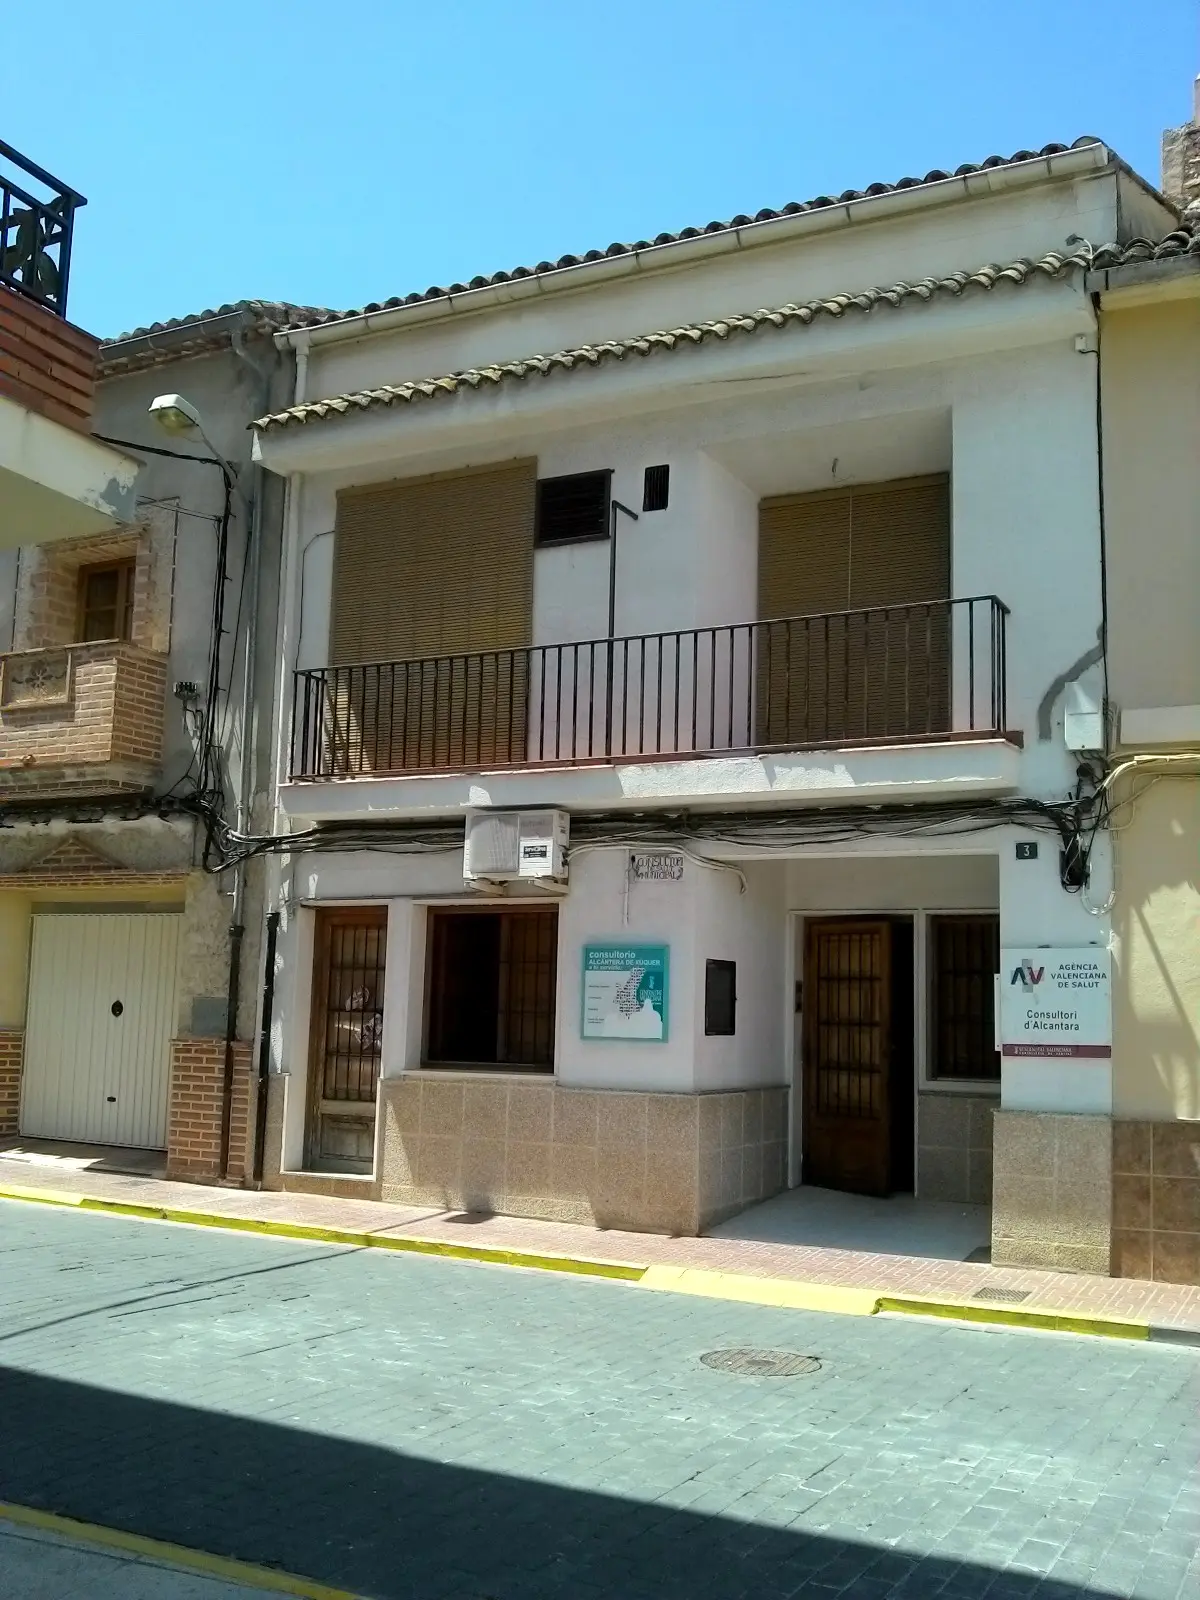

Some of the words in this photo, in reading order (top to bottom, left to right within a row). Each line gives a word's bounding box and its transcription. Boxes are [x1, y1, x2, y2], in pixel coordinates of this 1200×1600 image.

[1023, 844, 1031, 857] 3
[588, 950, 636, 959] consultorio
[1058, 962, 1098, 971] AGÈNCIA
[1026, 1009, 1078, 1020] Consultori
